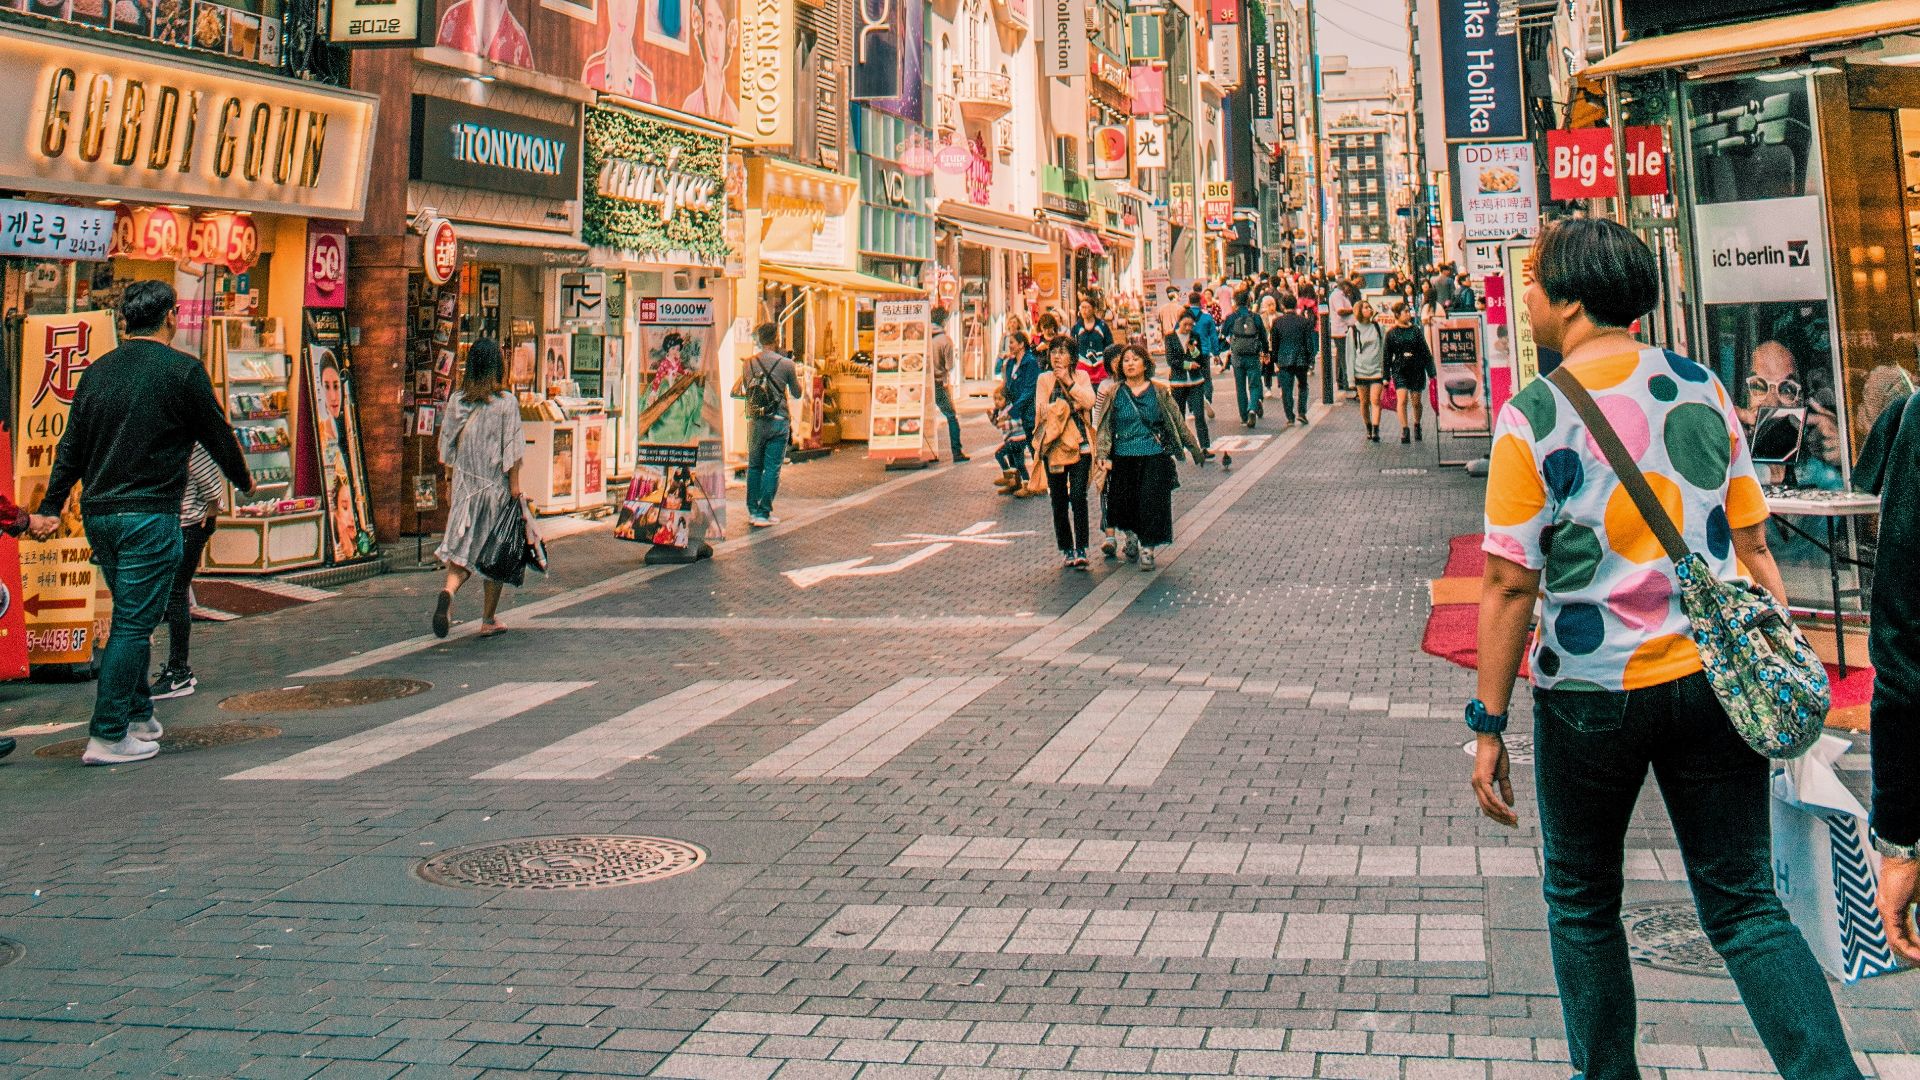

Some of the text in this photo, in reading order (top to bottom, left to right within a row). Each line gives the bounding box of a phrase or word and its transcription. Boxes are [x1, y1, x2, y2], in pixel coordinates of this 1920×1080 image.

[350, 18, 400, 34] 곱디고운
[1220, 9, 1235, 19] 3F
[1058, 0, 1071, 69] ollection
[1256, 45, 1267, 116] HOLLYS COFFEE
[1466, 48, 1496, 133] Holika
[213, 96, 328, 188] GOUN
[462, 123, 566, 175] TONYMOLY
[1138, 131, 1161, 157] 光
[1466, 148, 1493, 163] DD
[1554, 145, 1597, 187] Big
[1208, 185, 1229, 197] BIG
[1207, 203, 1230, 215] MART
[146, 218, 177, 255] 50
[190, 222, 219, 258] 50
[228, 224, 256, 261] 50
[314, 245, 340, 279] 50
[1712, 245, 1785, 267] ic! berlin
[72, 629, 87, 649] 3F
